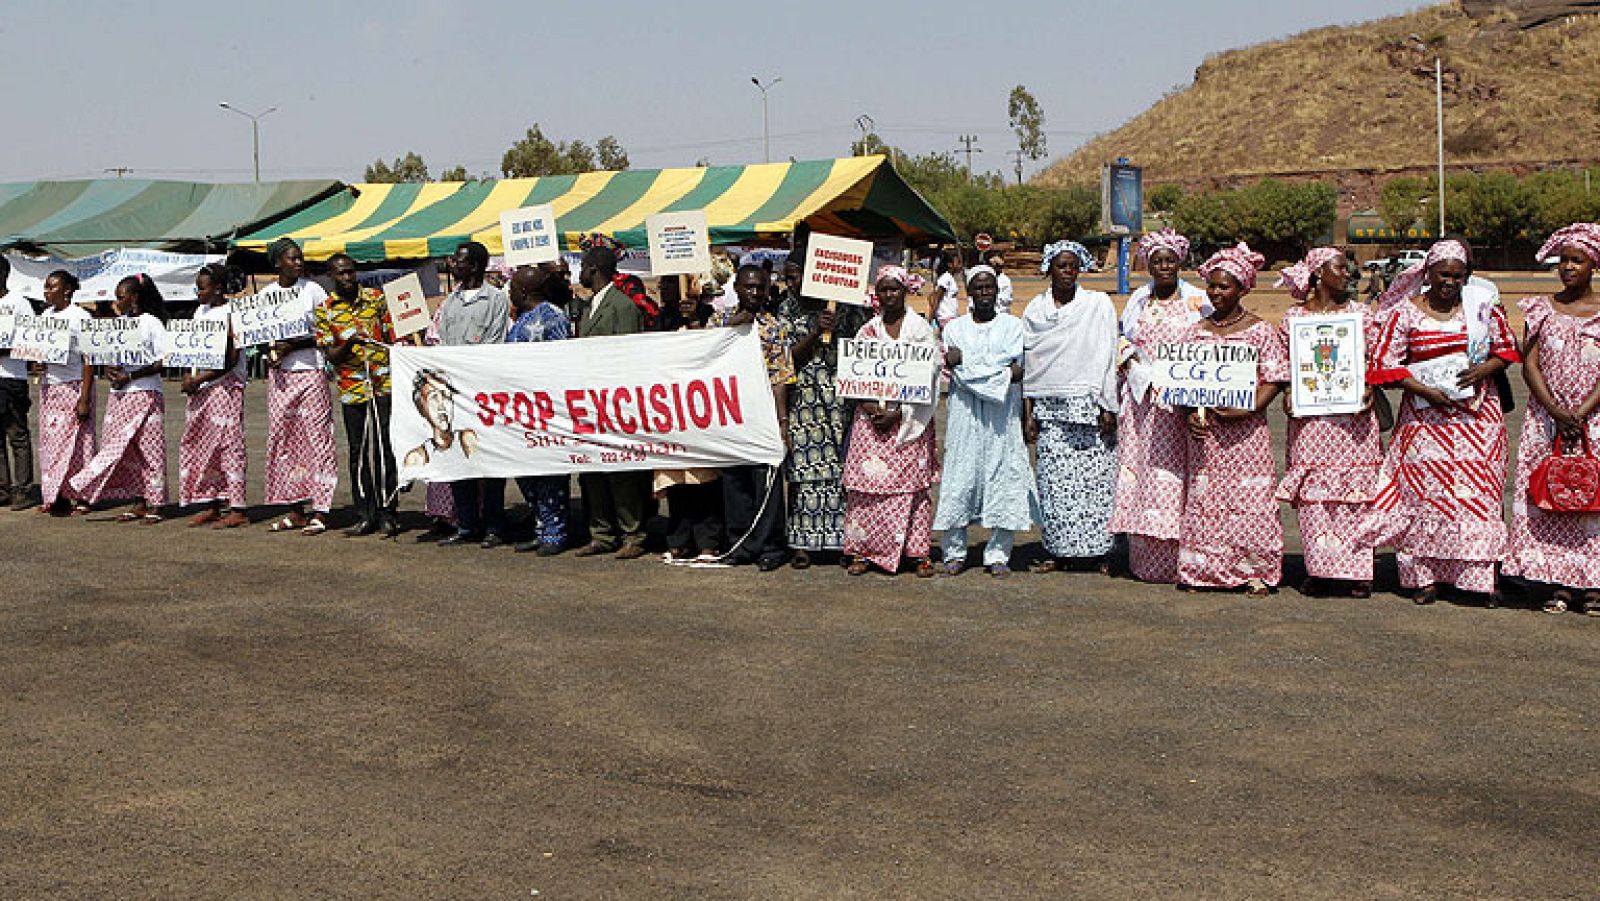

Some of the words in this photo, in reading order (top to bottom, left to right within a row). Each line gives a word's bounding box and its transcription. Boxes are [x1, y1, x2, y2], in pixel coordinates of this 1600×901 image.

[1355, 228, 1431, 238] STATON
[843, 339, 934, 362] DELEGATION
[1157, 343, 1257, 363] DELEGATION
[475, 391, 555, 432] STOP
[564, 375, 744, 435] EXCISION
